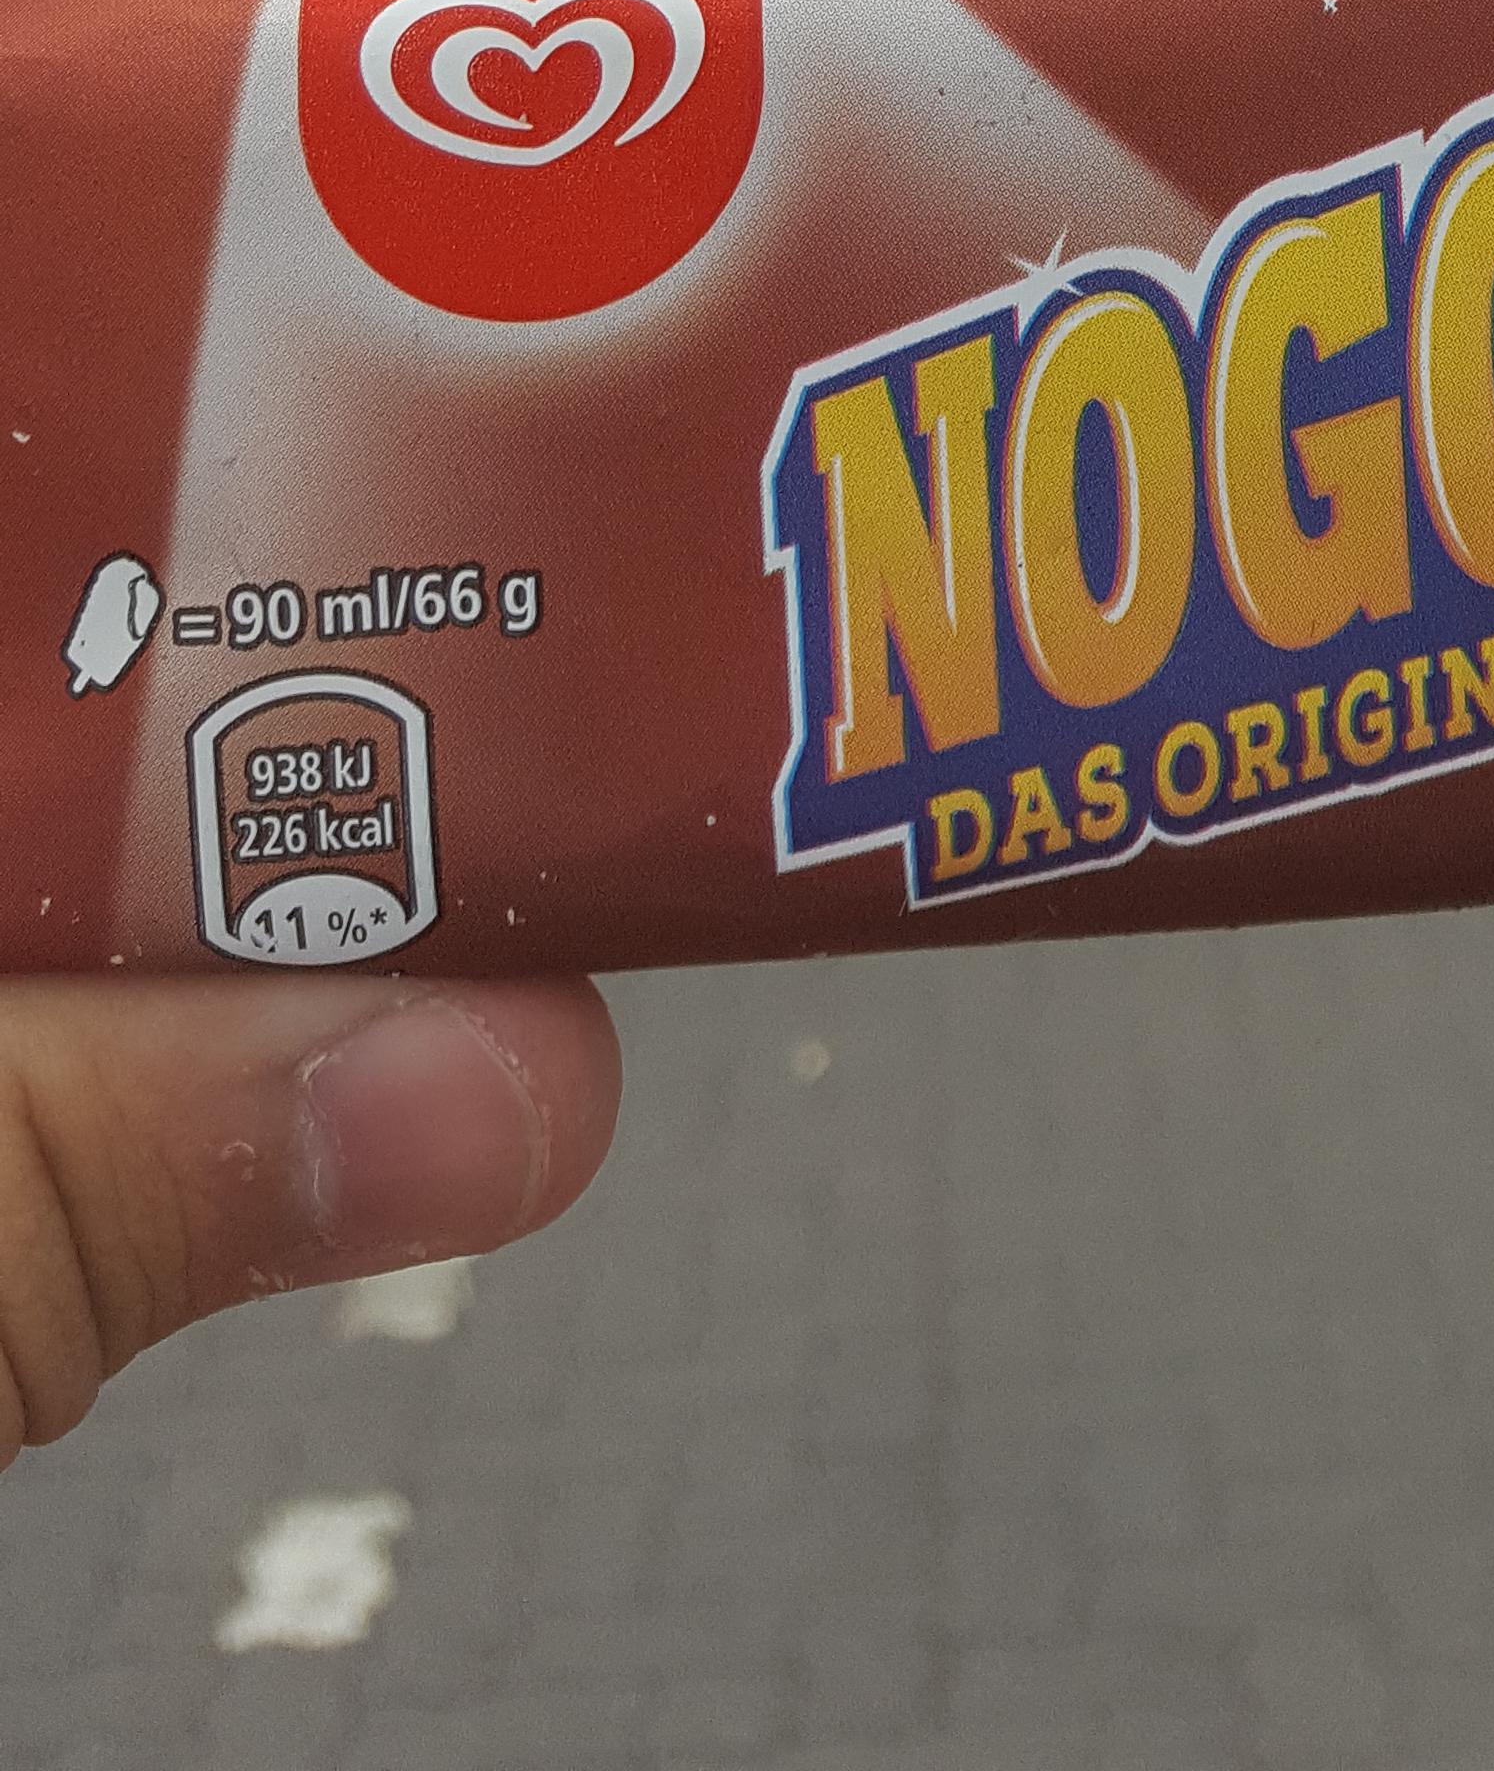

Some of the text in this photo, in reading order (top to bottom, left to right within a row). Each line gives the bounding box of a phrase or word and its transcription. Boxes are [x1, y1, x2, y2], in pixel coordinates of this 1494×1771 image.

[322, 570, 483, 637] ml/66
[503, 572, 539, 633] g
[252, 744, 372, 796] 938 kJ
[237, 804, 394, 859] 226 kcal
[929, 745, 1131, 882] DAS
[253, 905, 310, 953] 11
